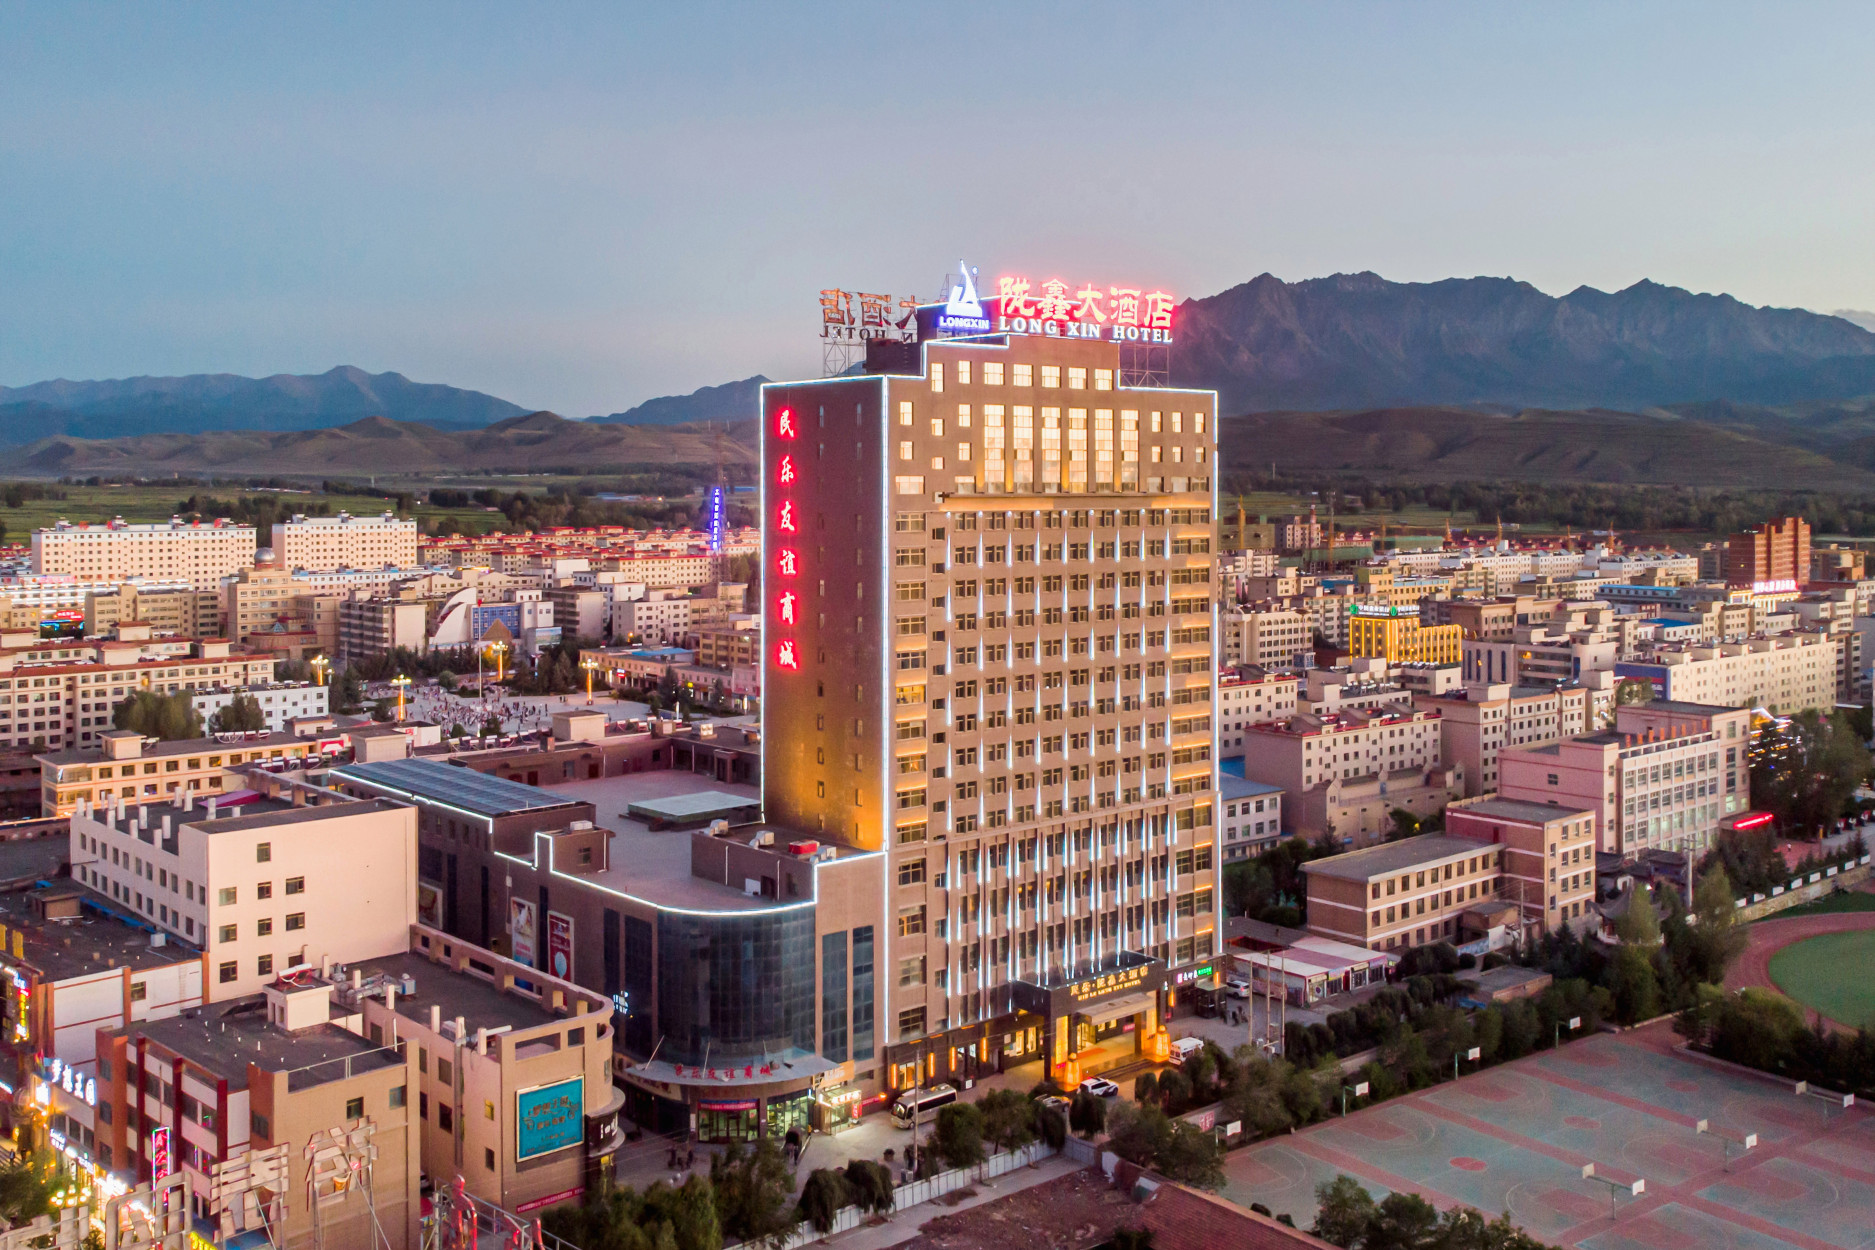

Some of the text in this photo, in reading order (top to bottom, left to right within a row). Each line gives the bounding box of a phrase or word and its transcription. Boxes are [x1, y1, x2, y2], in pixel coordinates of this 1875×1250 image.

[999, 276, 1174, 328] 陇鑫大酒店
[939, 316, 990, 329] LONGXIN
[999, 316, 1173, 343] LONG XIN HOTEL
[779, 409, 797, 669] 民乐友谊商城
